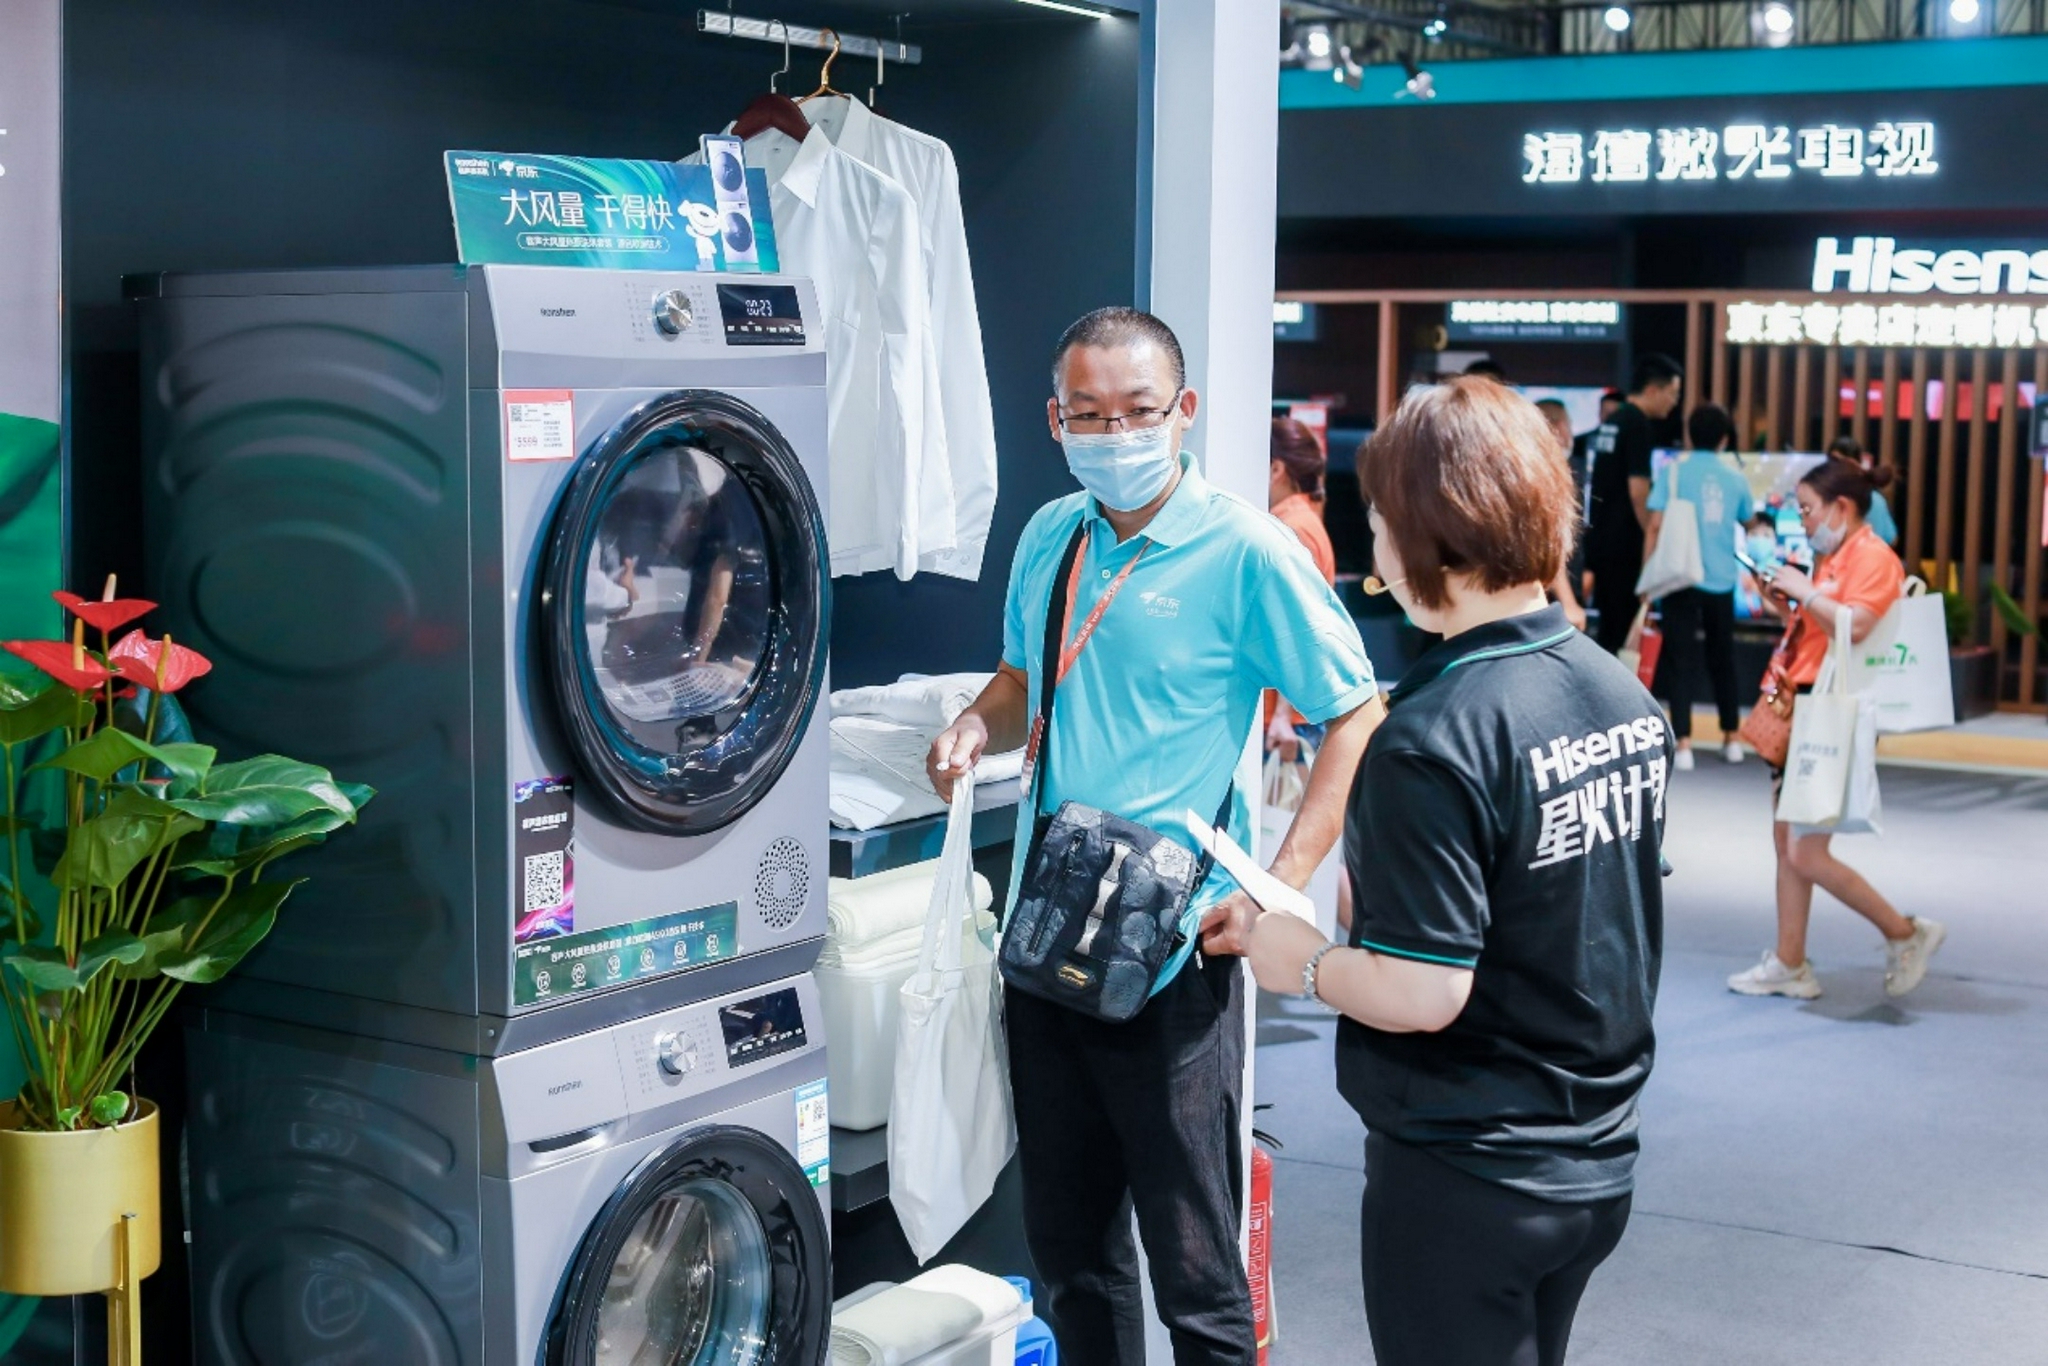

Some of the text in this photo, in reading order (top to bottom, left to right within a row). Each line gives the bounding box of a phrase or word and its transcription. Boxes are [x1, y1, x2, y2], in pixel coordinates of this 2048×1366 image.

[1522, 122, 1940, 184] 海信激光电视
[500, 188, 676, 232] 大风量 干得快
[1529, 715, 1666, 793] Hisense
